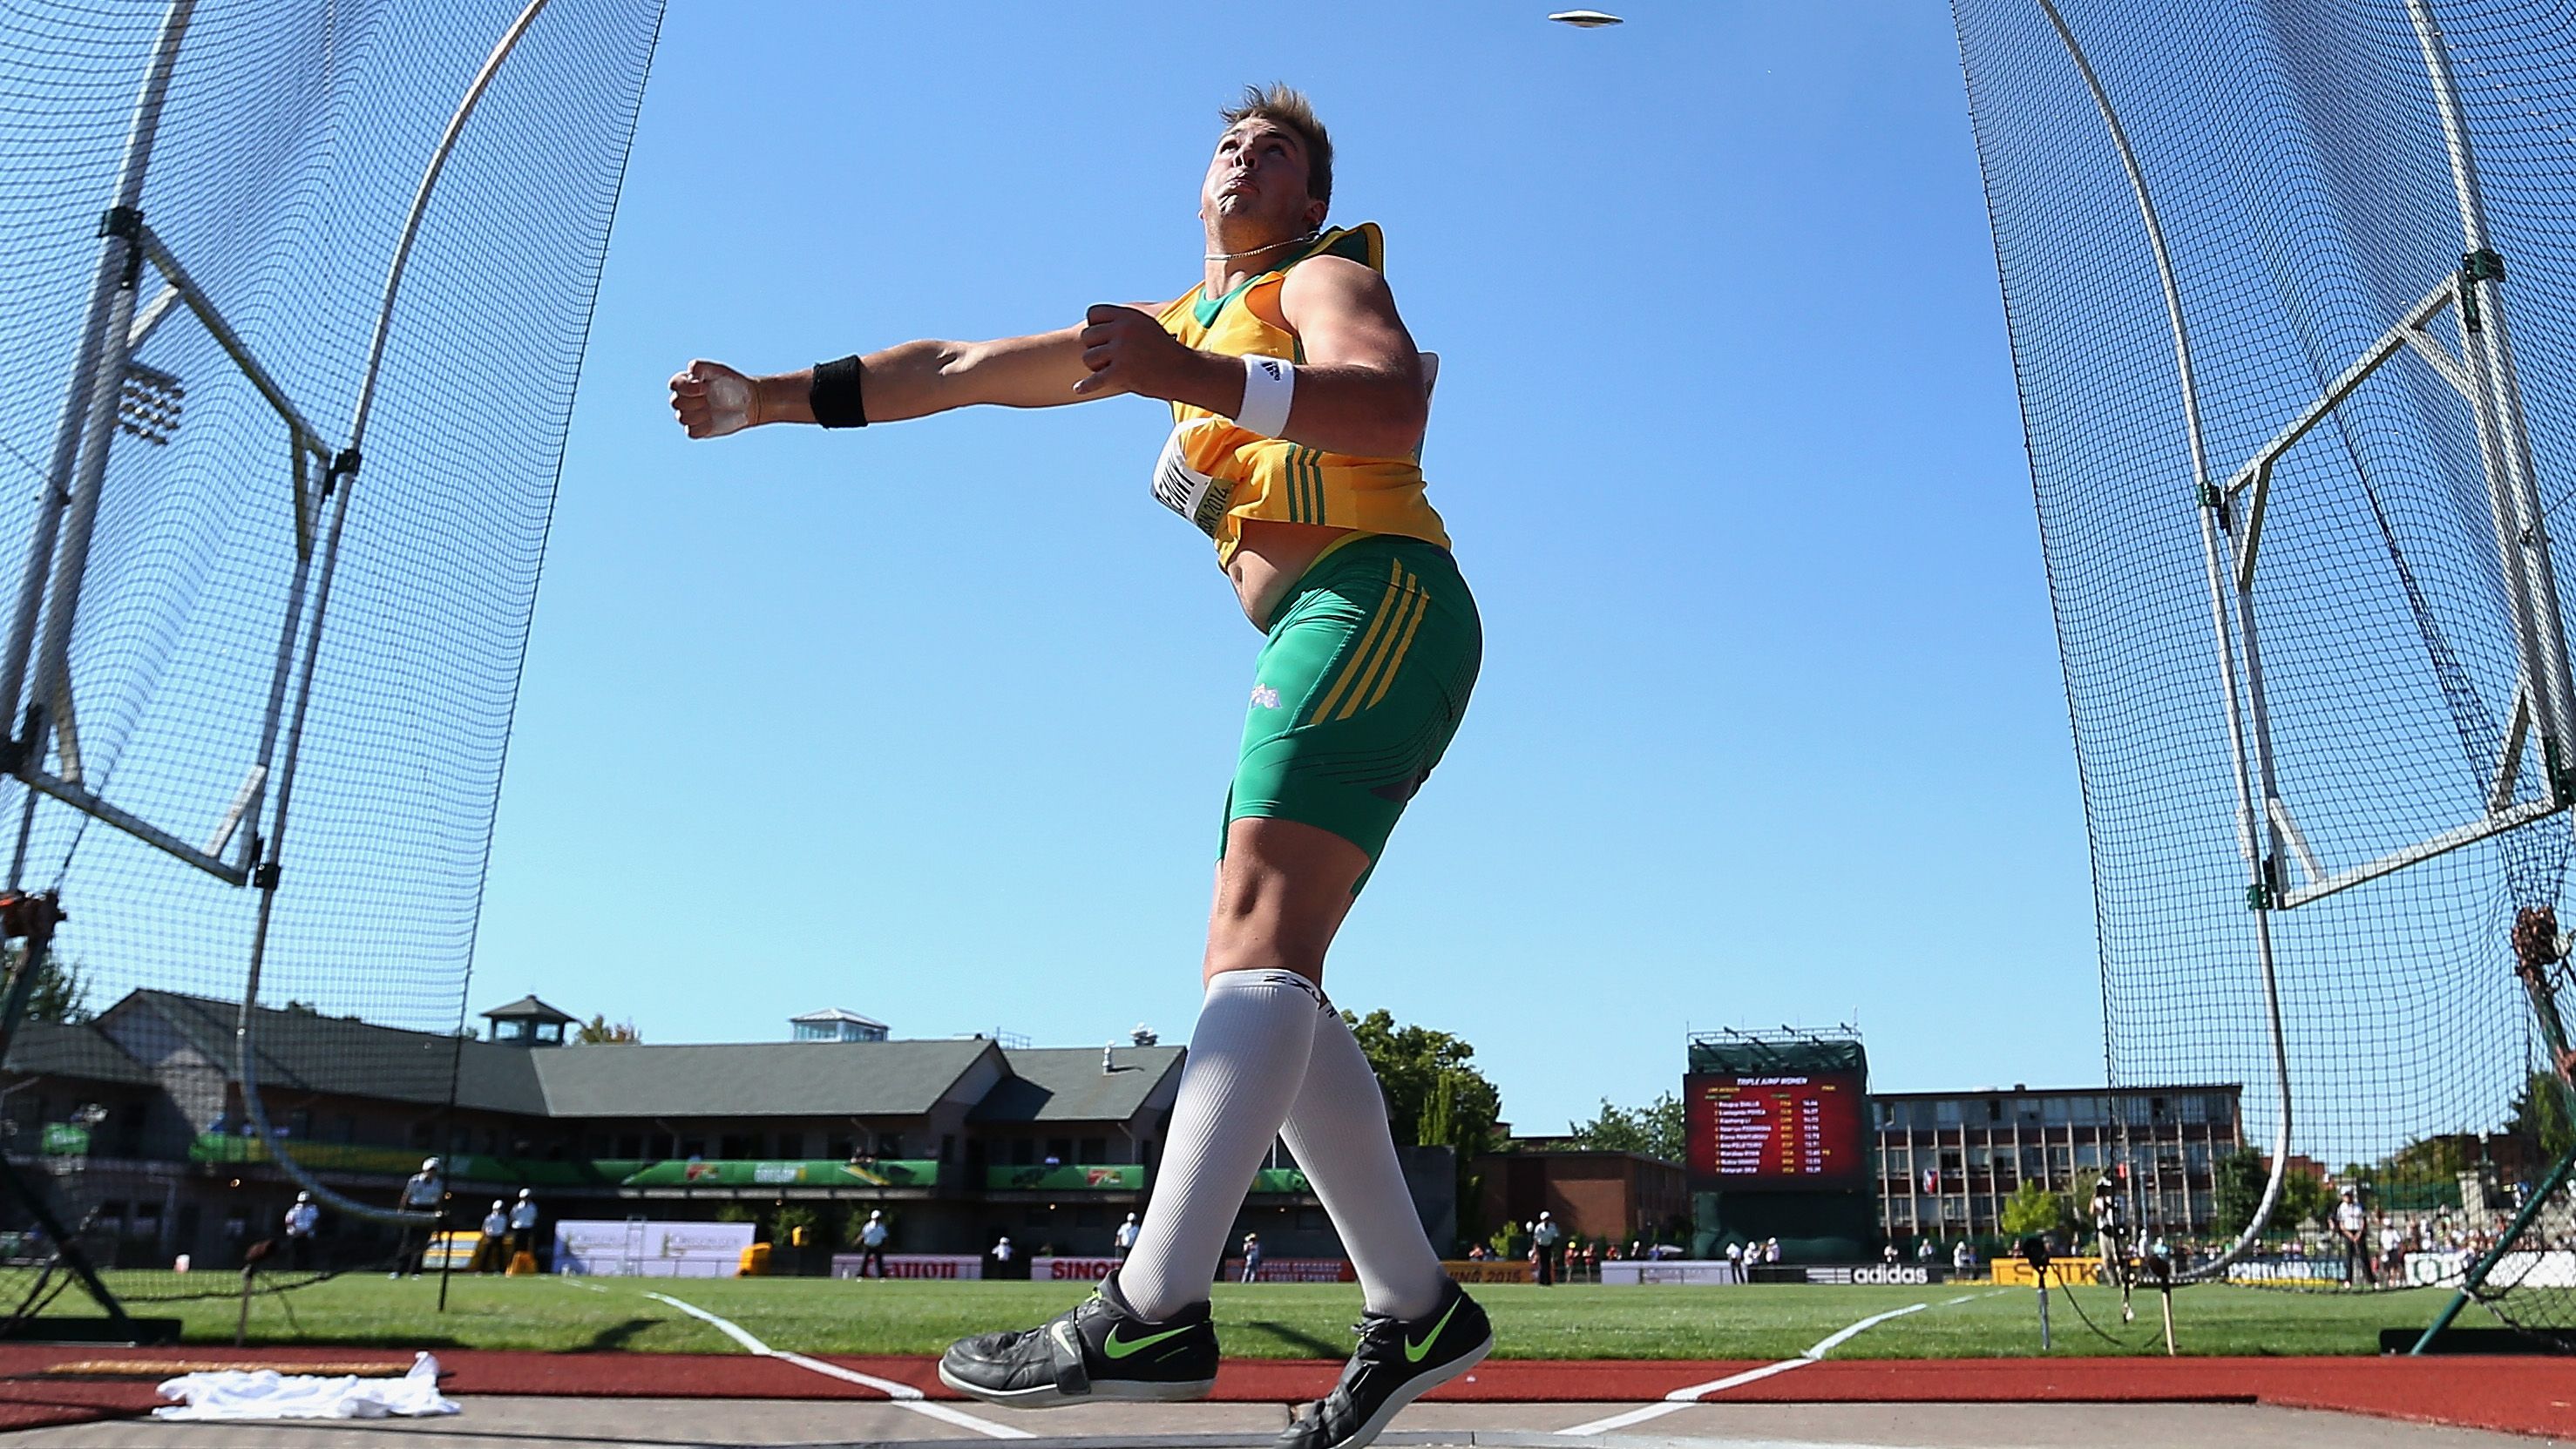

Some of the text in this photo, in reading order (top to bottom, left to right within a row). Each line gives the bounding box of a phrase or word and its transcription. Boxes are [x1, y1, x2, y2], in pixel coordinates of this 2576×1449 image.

[1203, 485, 1230, 517] 2014
[1737, 1077, 1808, 1086] TRIPLE JUMP WOMEN
[1488, 1270, 1522, 1283] 2015
[1853, 1263, 1929, 1284] adidas
